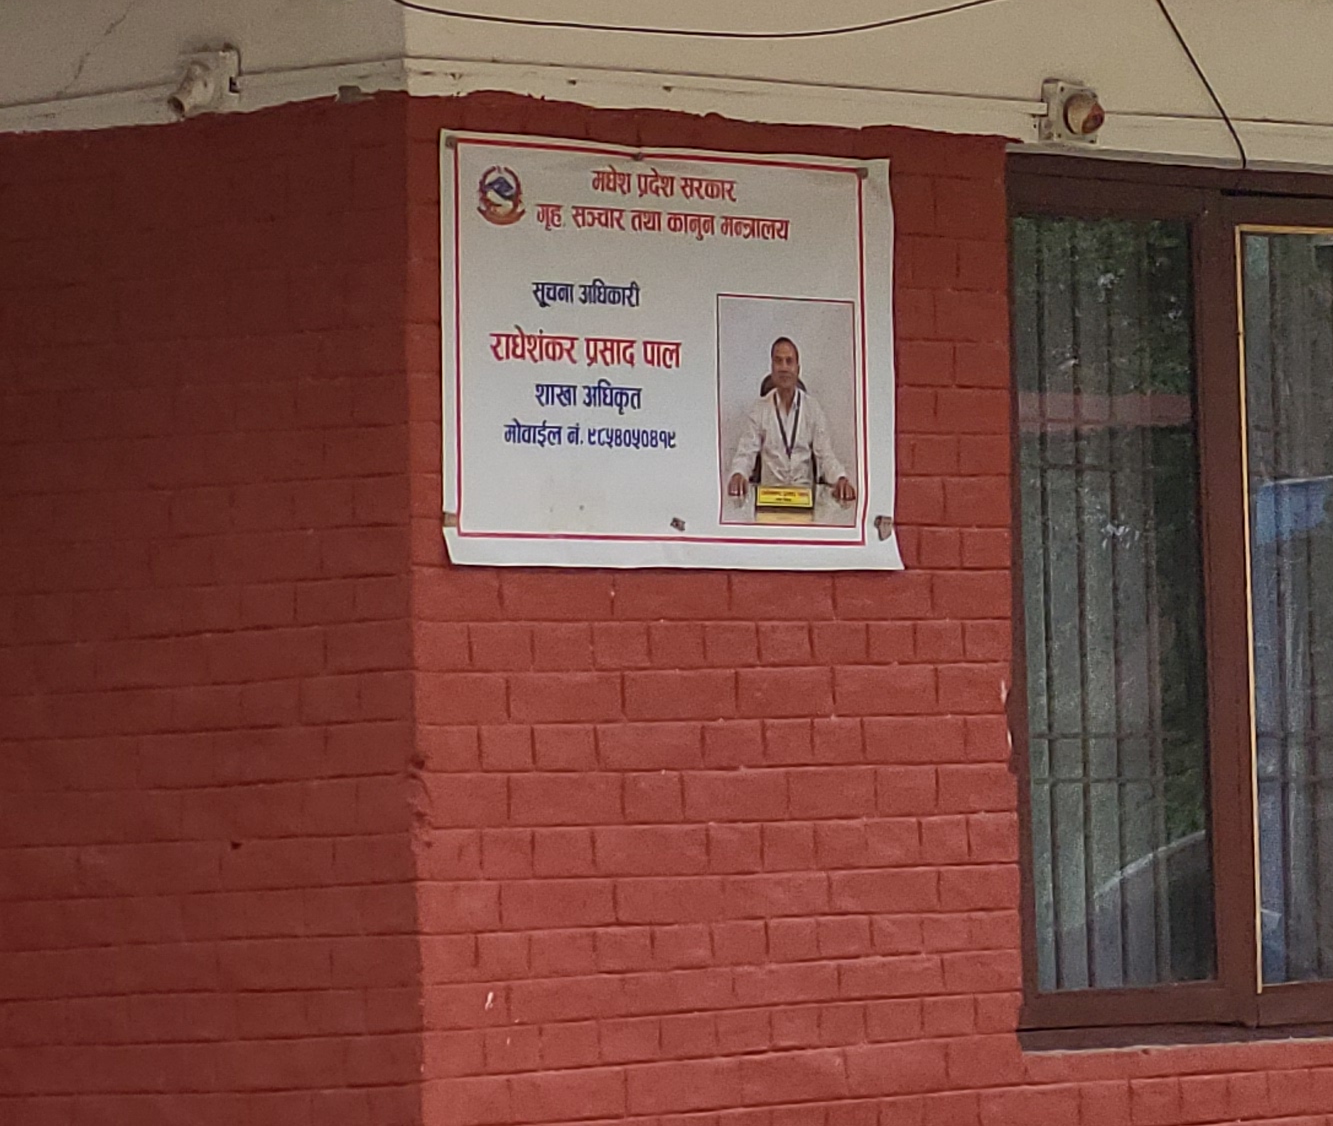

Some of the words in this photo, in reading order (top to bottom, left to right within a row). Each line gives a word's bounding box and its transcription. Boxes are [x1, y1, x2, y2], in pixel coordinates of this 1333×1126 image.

[592, 165, 631, 194] मधेश
[637, 168, 675, 198] प्रदेश
[679, 176, 736, 202] सरकार
[571, 205, 626, 231] सञ्चार
[631, 210, 662, 231] तथा
[667, 212, 715, 240] कानुन
[720, 216, 790, 241] मन्त्रालय
[532, 282, 575, 308] सूचना
[578, 278, 641, 308] अधिकारी
[489, 325, 579, 364] राधेशंकर
[585, 336, 636, 368] प्रसाद
[642, 340, 682, 369] पाल
[535, 383, 578, 407] शाखा
[582, 378, 642, 415] अधिकृत
